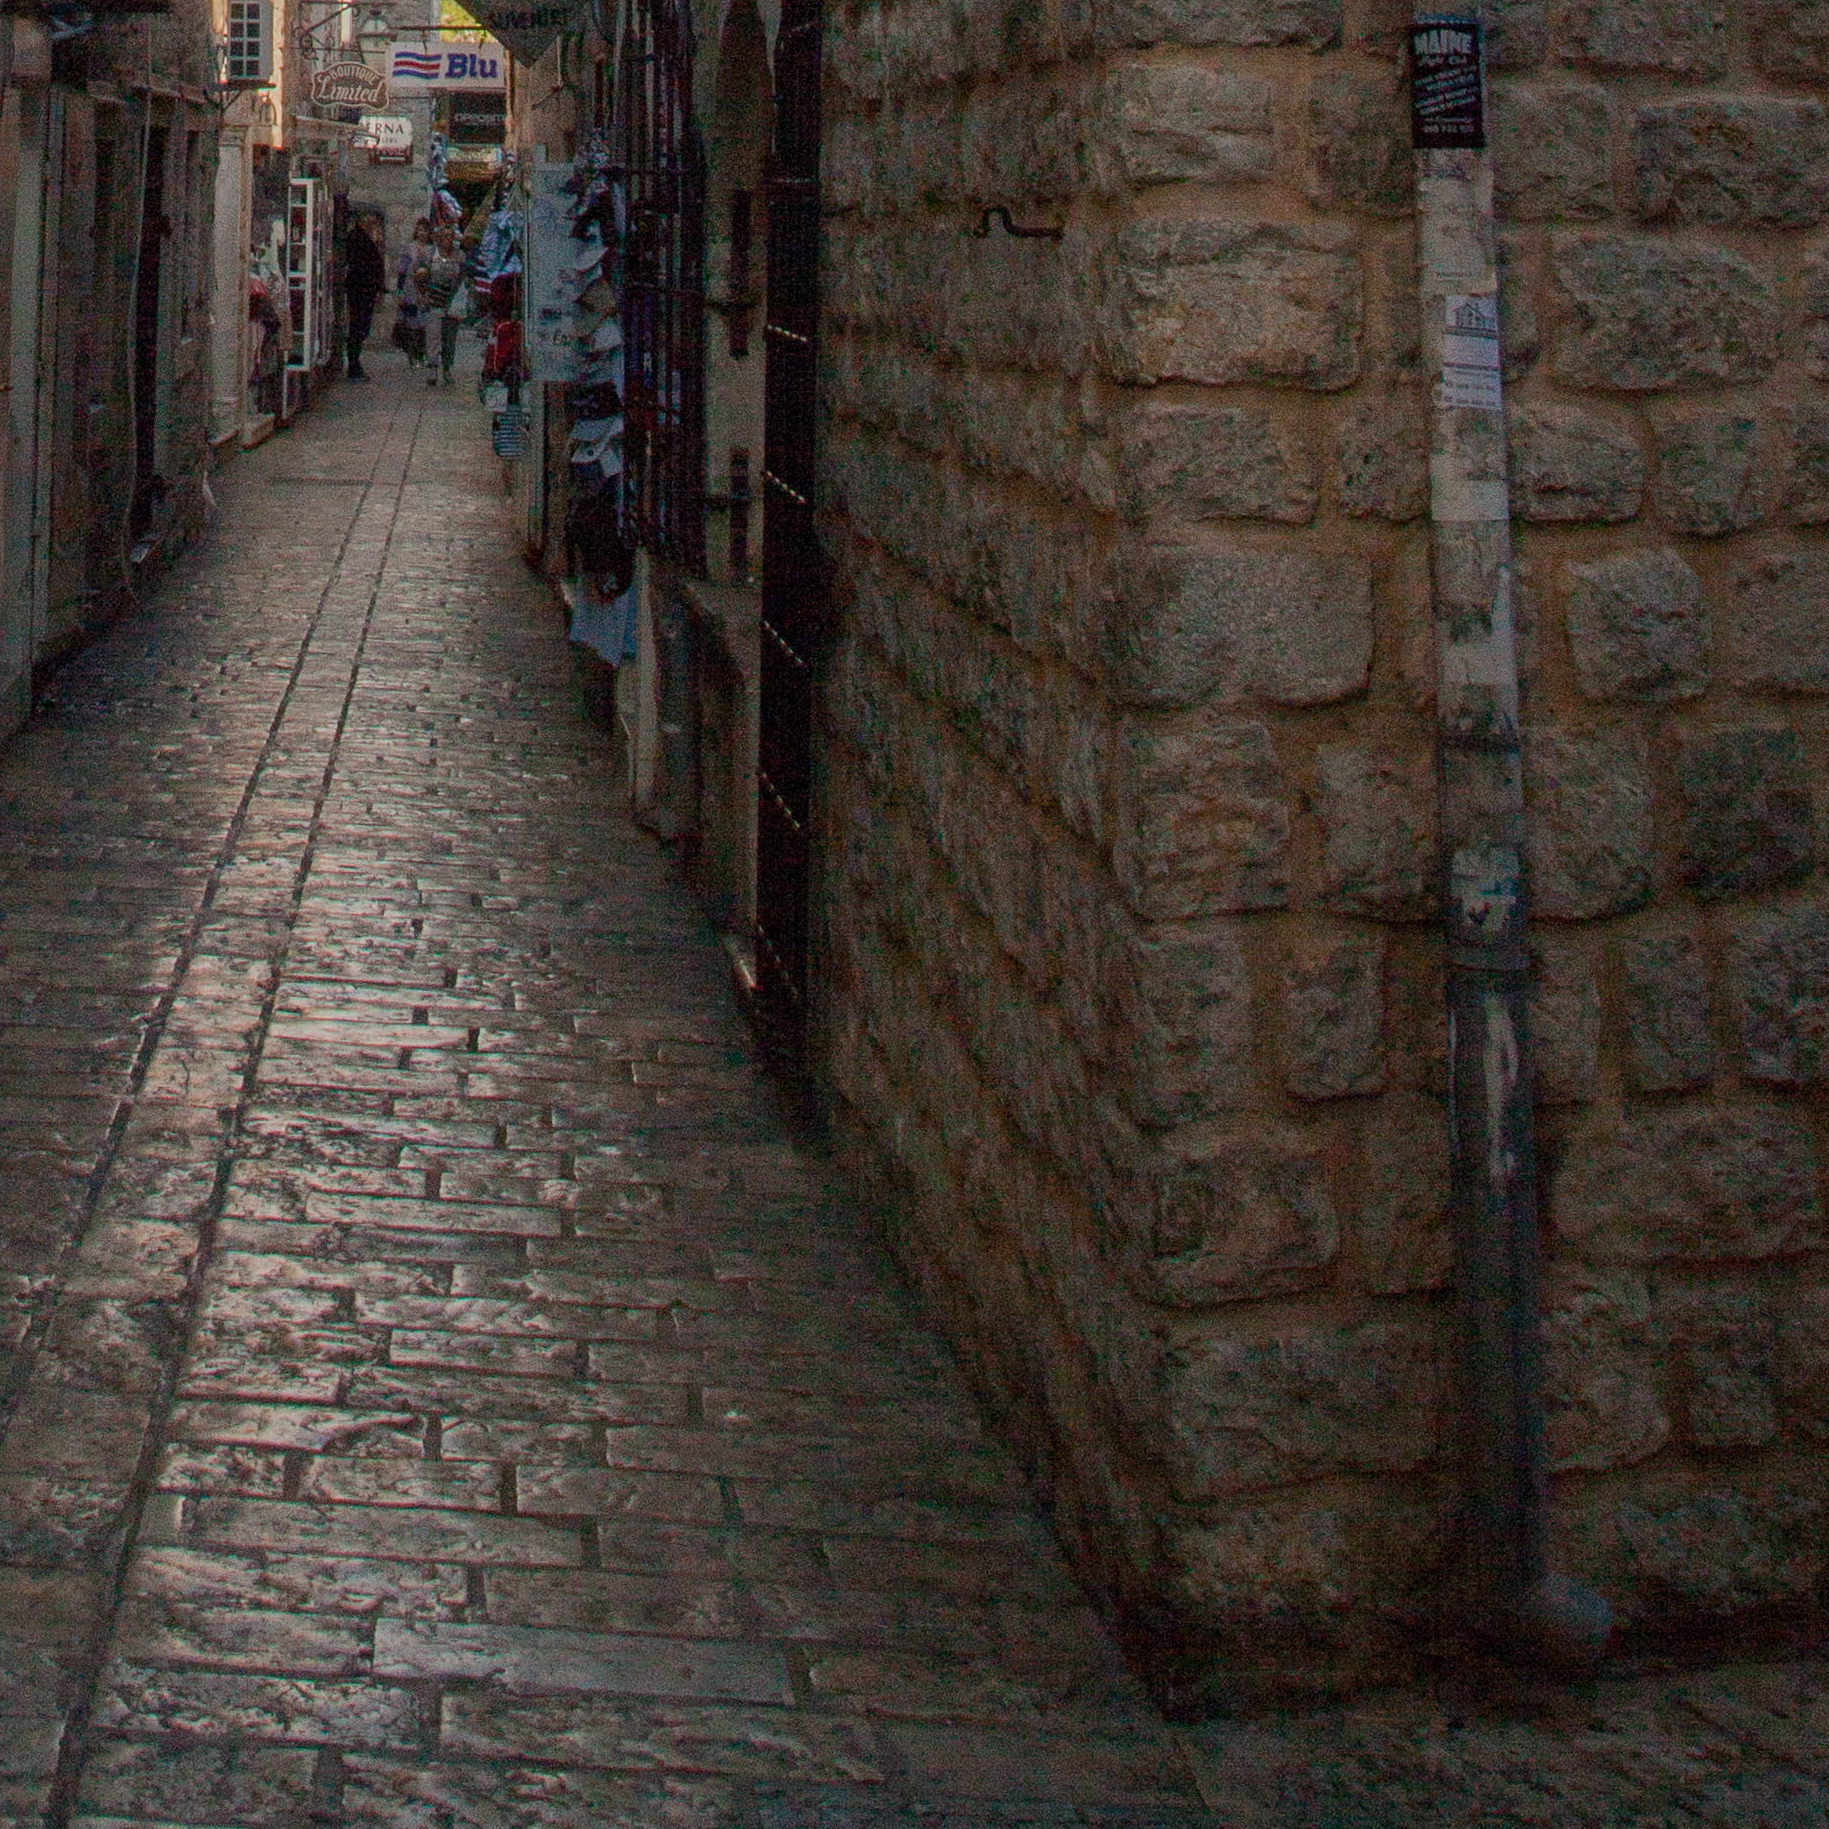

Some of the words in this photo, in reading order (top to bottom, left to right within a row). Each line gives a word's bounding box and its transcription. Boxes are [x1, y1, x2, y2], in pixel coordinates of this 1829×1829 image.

[329, 64, 380, 86] BOUTIQUE
[445, 52, 498, 79] Blu
[317, 75, 384, 102] Limited
